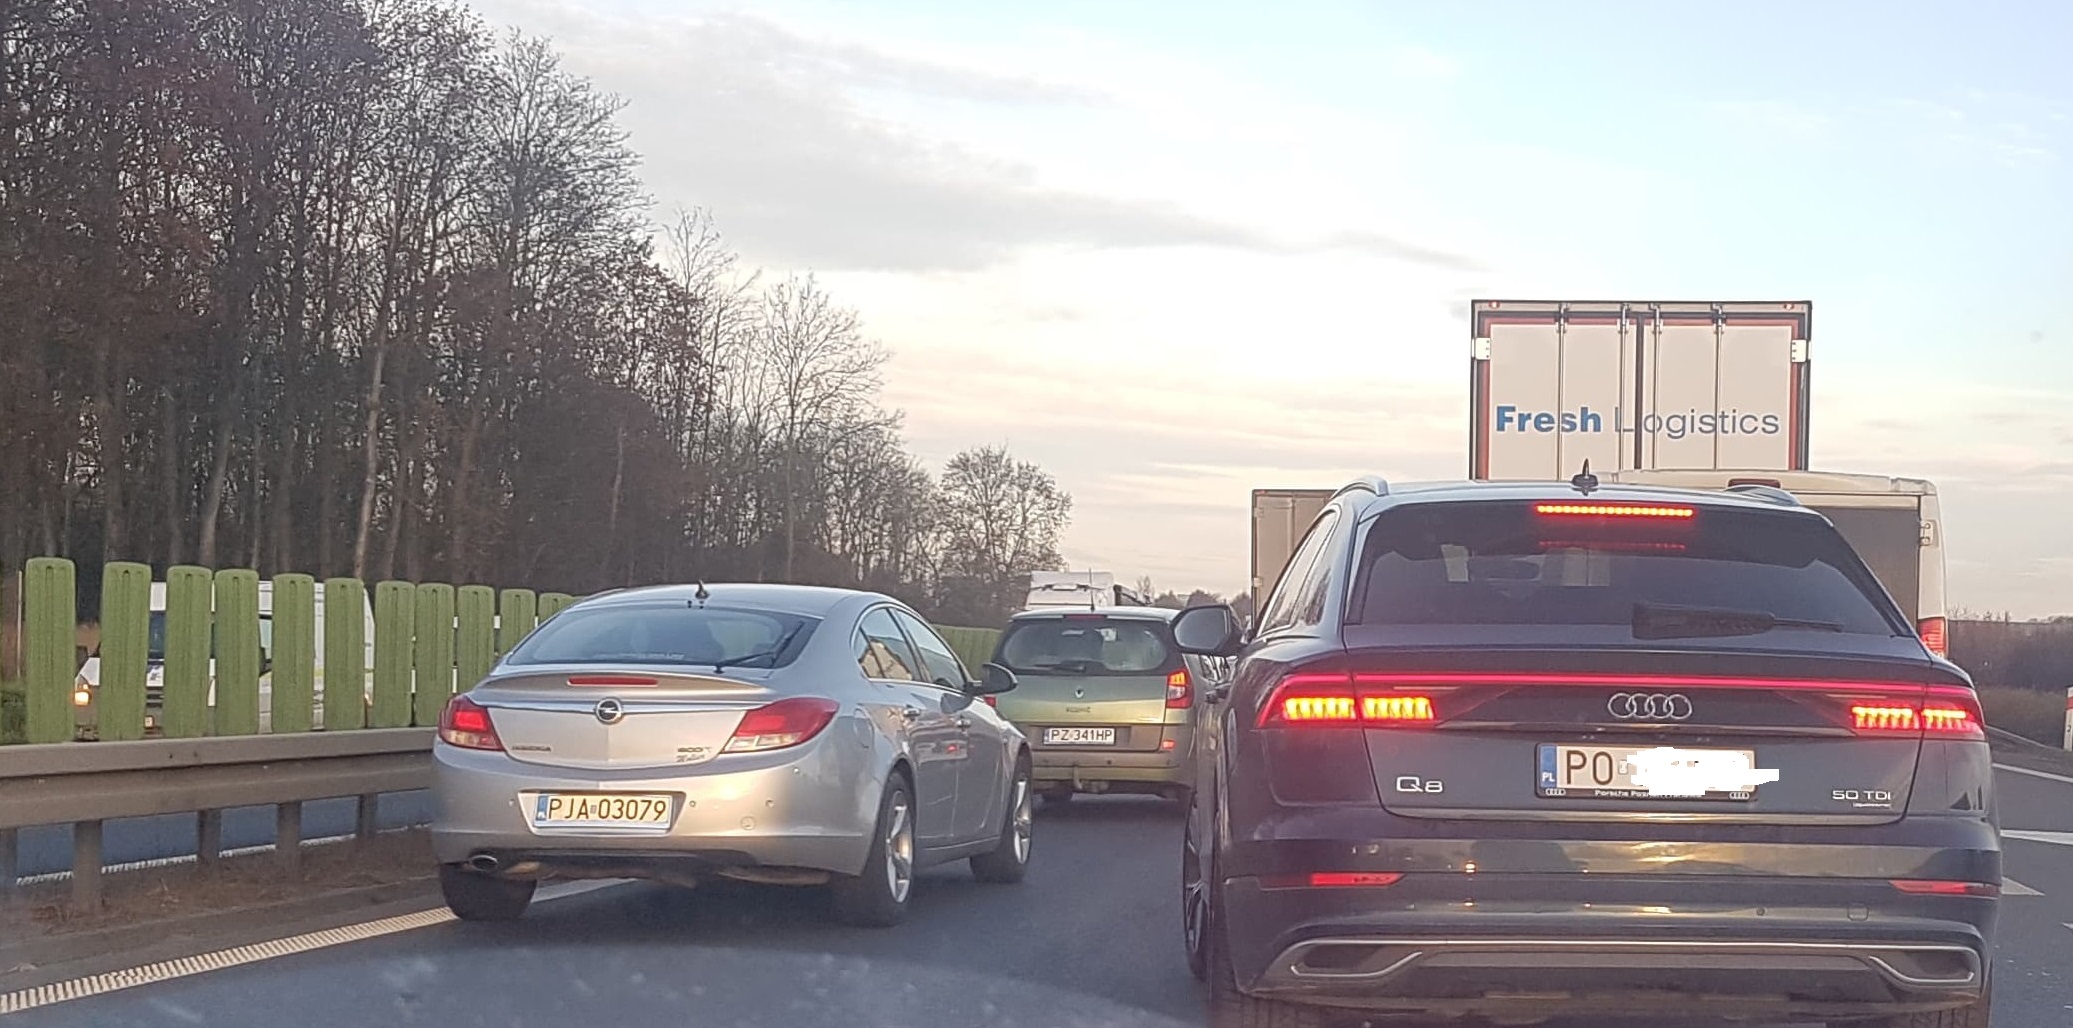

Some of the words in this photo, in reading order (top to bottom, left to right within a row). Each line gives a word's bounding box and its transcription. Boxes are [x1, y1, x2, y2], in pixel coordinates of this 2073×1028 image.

[1495, 405, 1602, 433] Fresh
[1614, 406, 1780, 439] Logistics
[1051, 729, 1069, 741] PZ
[1073, 729, 1113, 742] 341HP
[1566, 750, 1614, 786] PO
[1396, 776, 1443, 793] Q8
[1541, 771, 1556, 783] PL
[1832, 790, 1859, 800] 50
[1863, 790, 1891, 801] TDI
[548, 797, 590, 820] PJA
[597, 798, 667, 822] 03079
